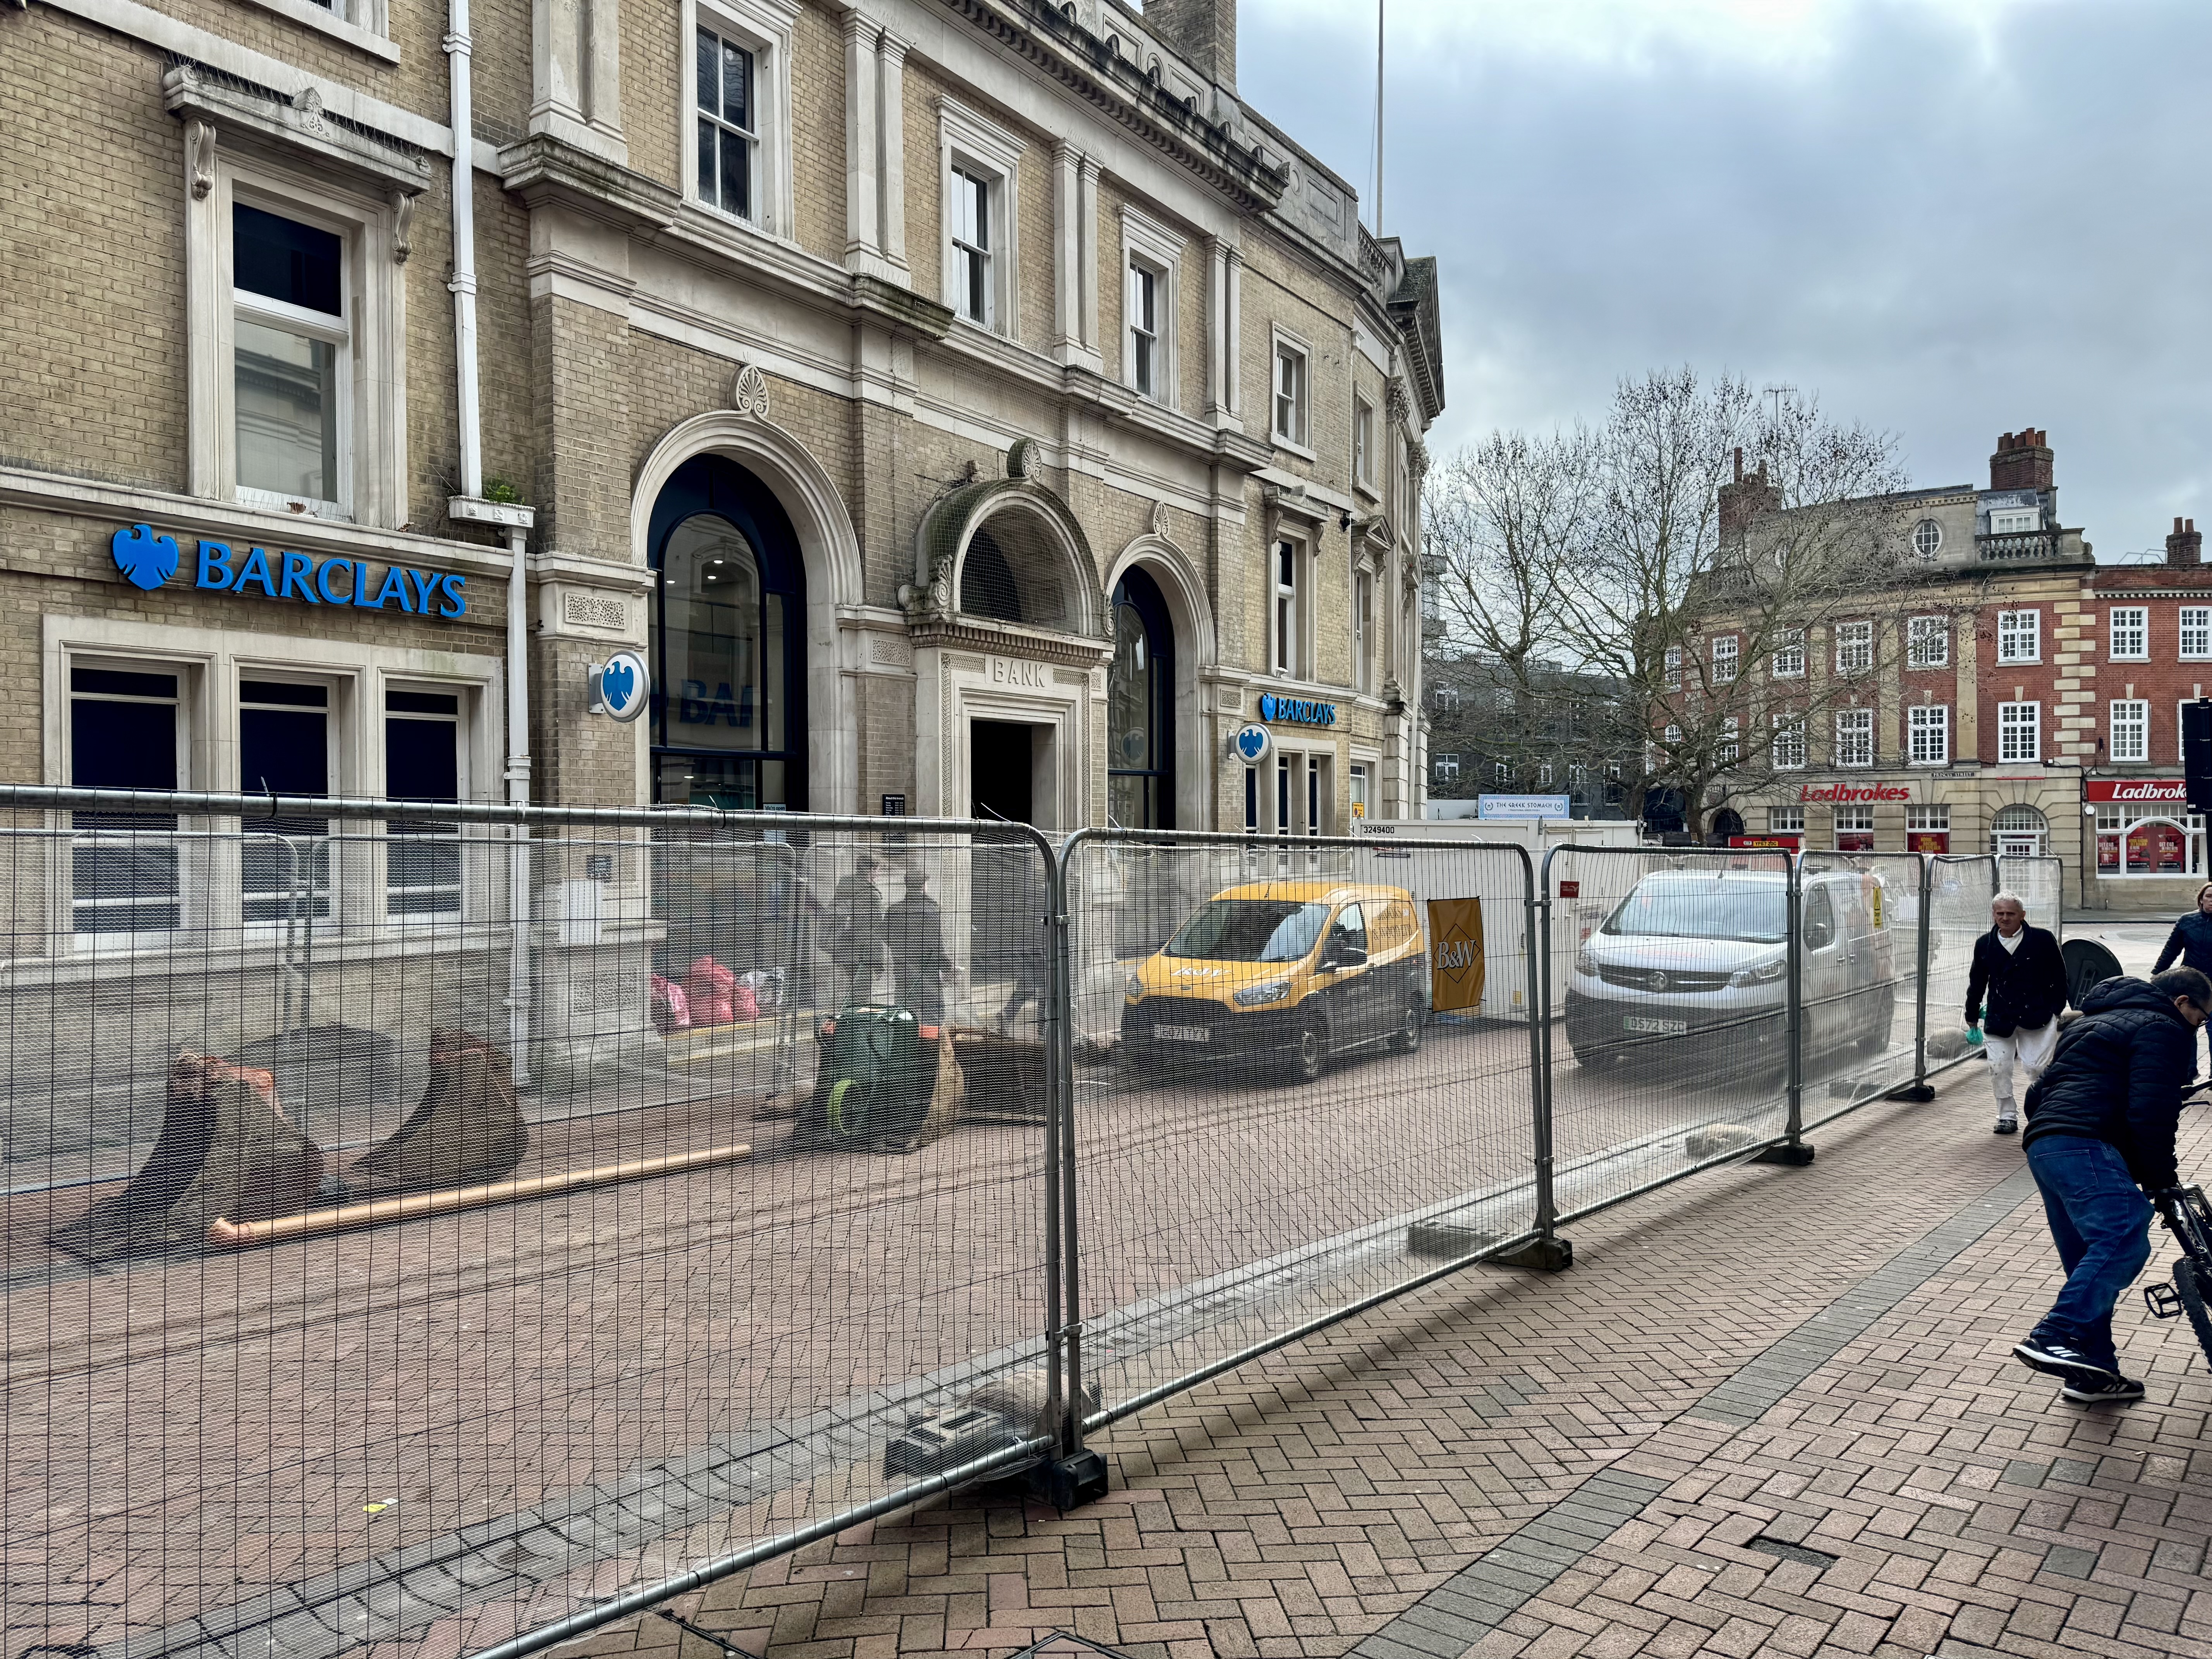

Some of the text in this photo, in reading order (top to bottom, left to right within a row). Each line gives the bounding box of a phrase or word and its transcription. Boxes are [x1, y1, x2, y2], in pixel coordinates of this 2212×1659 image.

[196, 539, 466, 618] BARCLAYS
[994, 658, 1045, 687] BANK
[1277, 697, 1336, 725] BARCLAYS
[1802, 783, 1909, 801] Ladbrokes
[2112, 783, 2187, 799] Ladbrok
[1437, 939, 1476, 969] B&W
